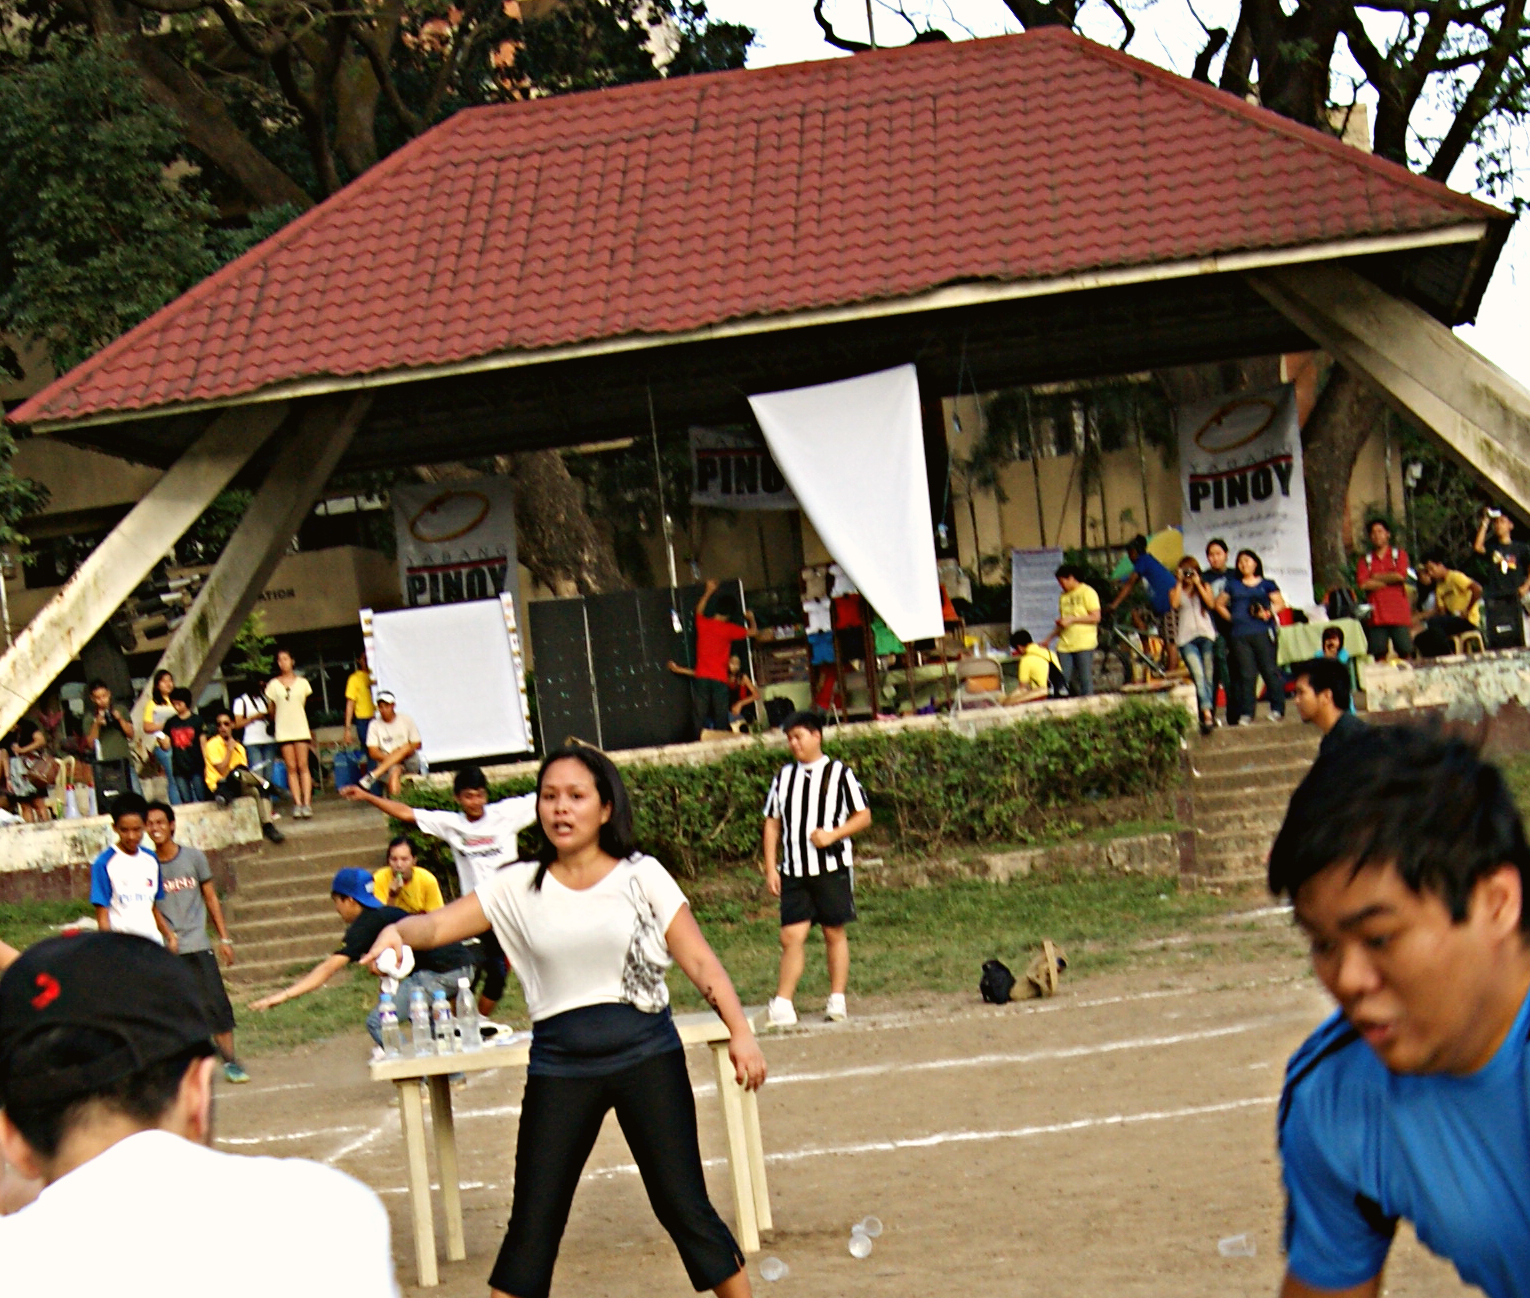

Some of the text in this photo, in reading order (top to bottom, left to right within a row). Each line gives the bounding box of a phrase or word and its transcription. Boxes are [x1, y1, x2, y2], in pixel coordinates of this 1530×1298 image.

[697, 456, 785, 494] PINO
[1190, 460, 1293, 512] PINOY
[406, 545, 508, 566] YABANG
[406, 564, 508, 606] PINOY
